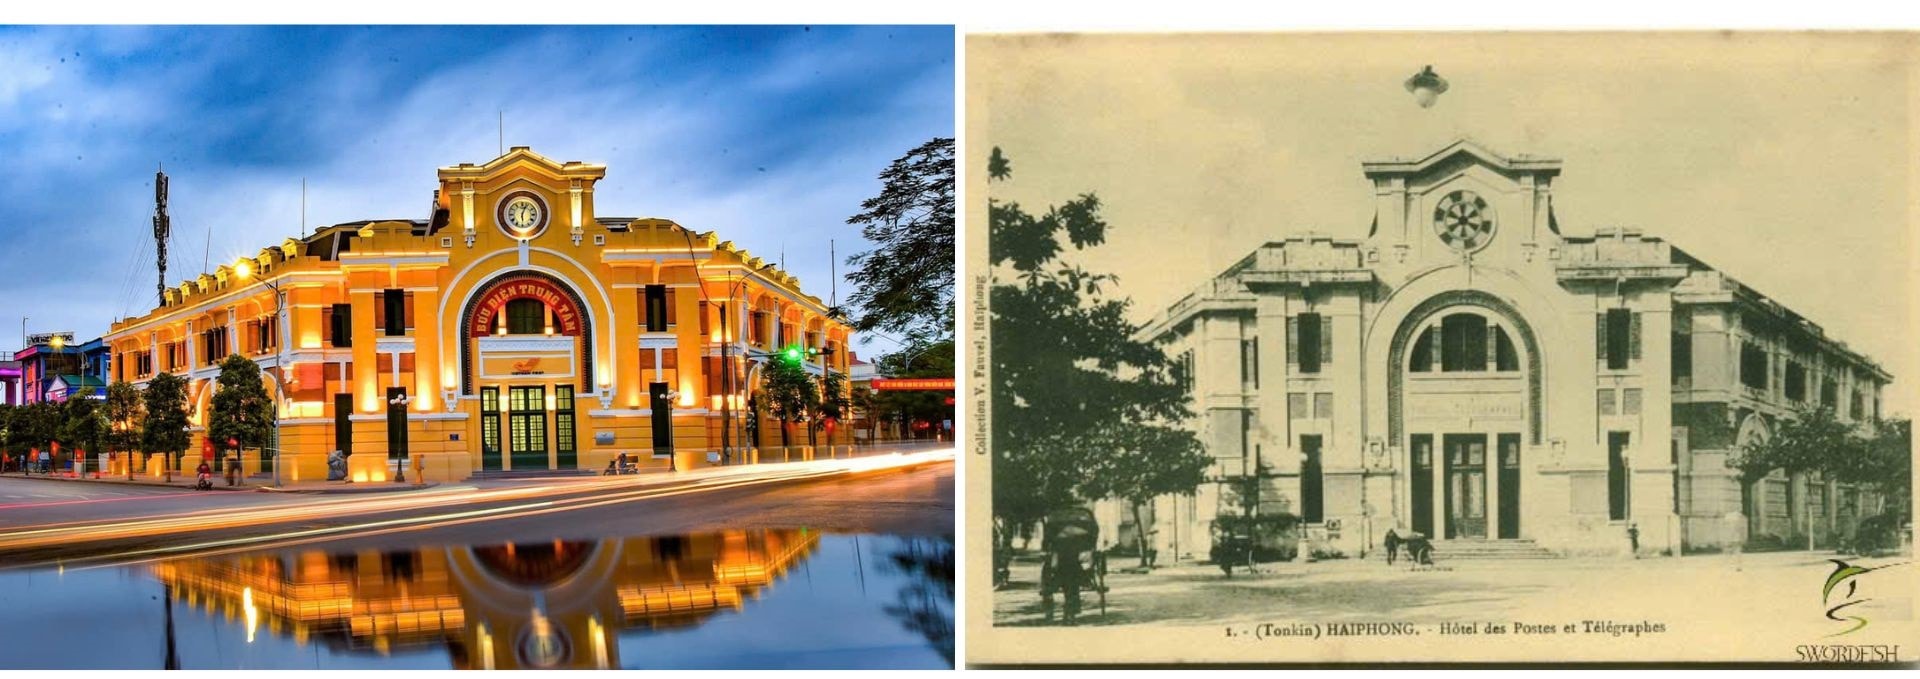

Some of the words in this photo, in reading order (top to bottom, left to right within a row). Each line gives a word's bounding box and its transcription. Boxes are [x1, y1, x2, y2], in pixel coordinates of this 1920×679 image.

[519, 284, 560, 306] TRUNG
[974, 275, 988, 333] Haiphong
[974, 383, 986, 397] V.
[974, 400, 987, 456] Collection
[1255, 623, 1321, 641] (Tonkin)
[1326, 622, 1420, 636] HAIPHONG.
[1439, 621, 1477, 635] Hôtel
[1484, 622, 1506, 635] des
[1513, 621, 1557, 634] Postes
[1563, 622, 1576, 634] et
[1581, 620, 1667, 637] Télégraphes
